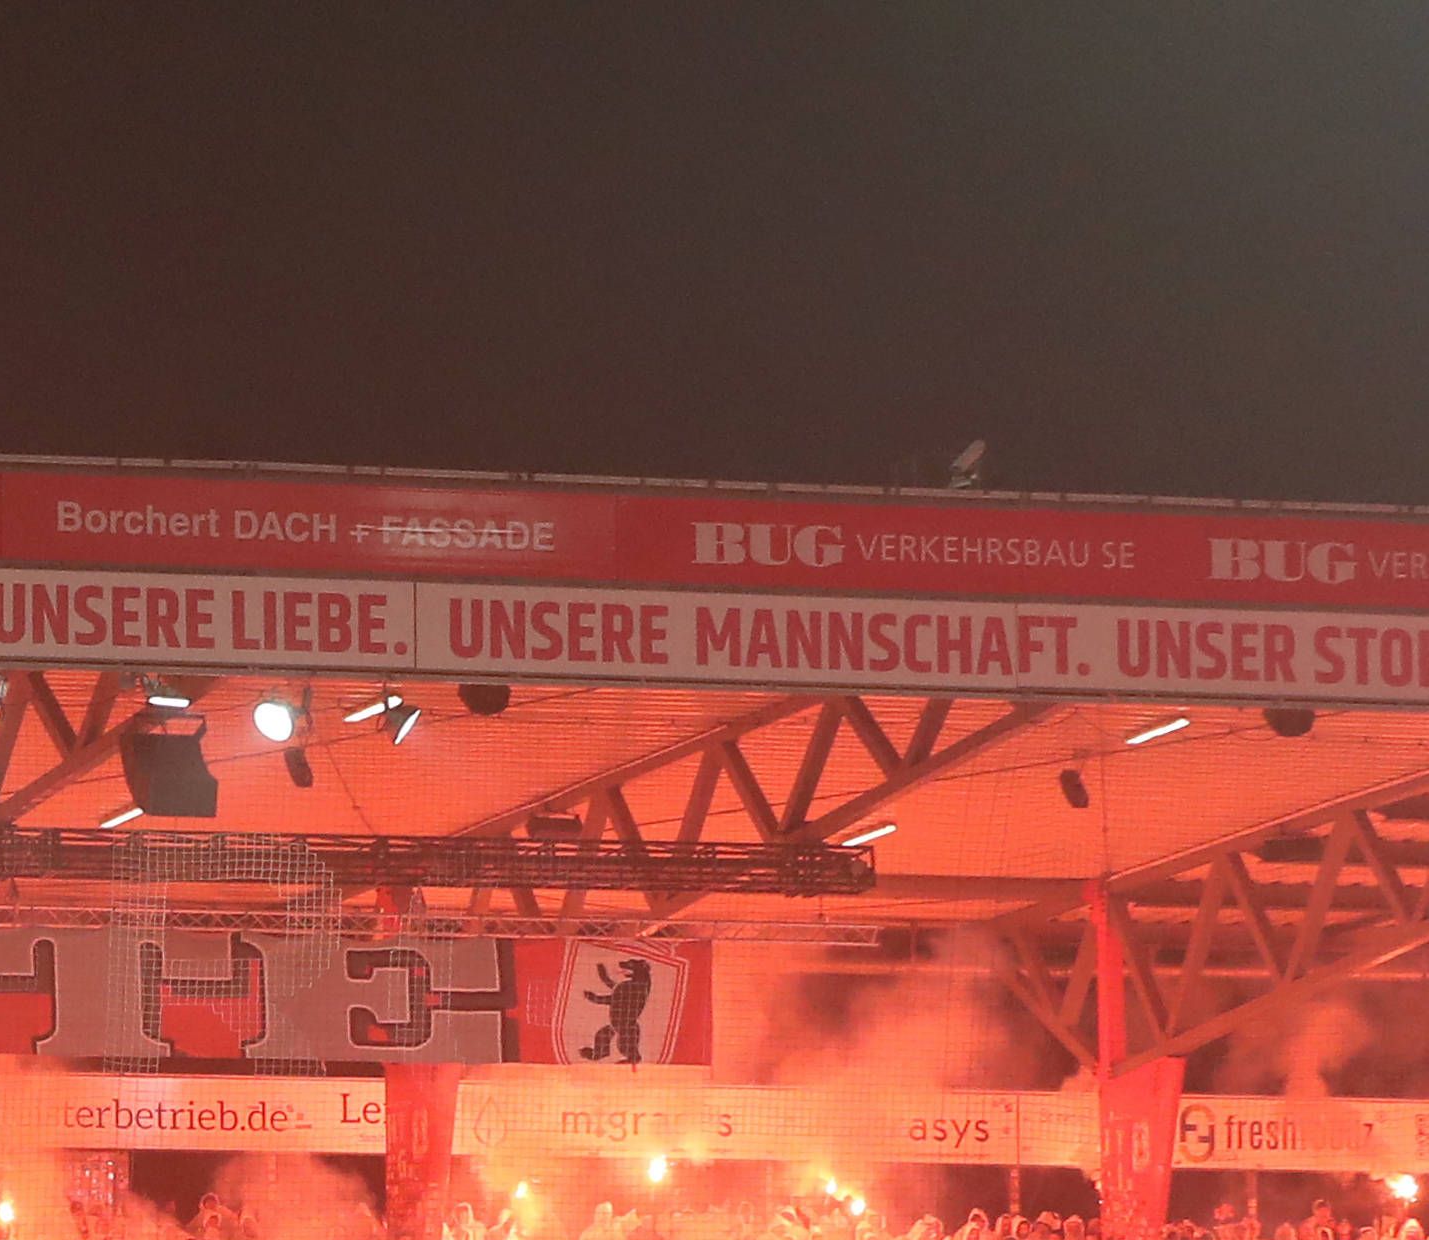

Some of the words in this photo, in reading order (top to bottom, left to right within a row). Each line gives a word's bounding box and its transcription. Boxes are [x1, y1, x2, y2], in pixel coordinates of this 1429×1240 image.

[57, 501, 220, 539] Borchert
[234, 510, 337, 543] DACH
[350, 523, 371, 544] +
[381, 515, 556, 552] FASSADE
[691, 521, 846, 568] BUG
[855, 533, 1090, 568] VERKEHRSBAU
[1103, 541, 1136, 570] SE
[1206, 537, 1358, 584] BUG
[232, 590, 408, 655] LIEBE.
[449, 598, 669, 664] UNSERE
[696, 606, 1091, 677] MANNSCHAFT.
[1117, 618, 1297, 683] UNSER
[340, 1092, 386, 1127] Le
